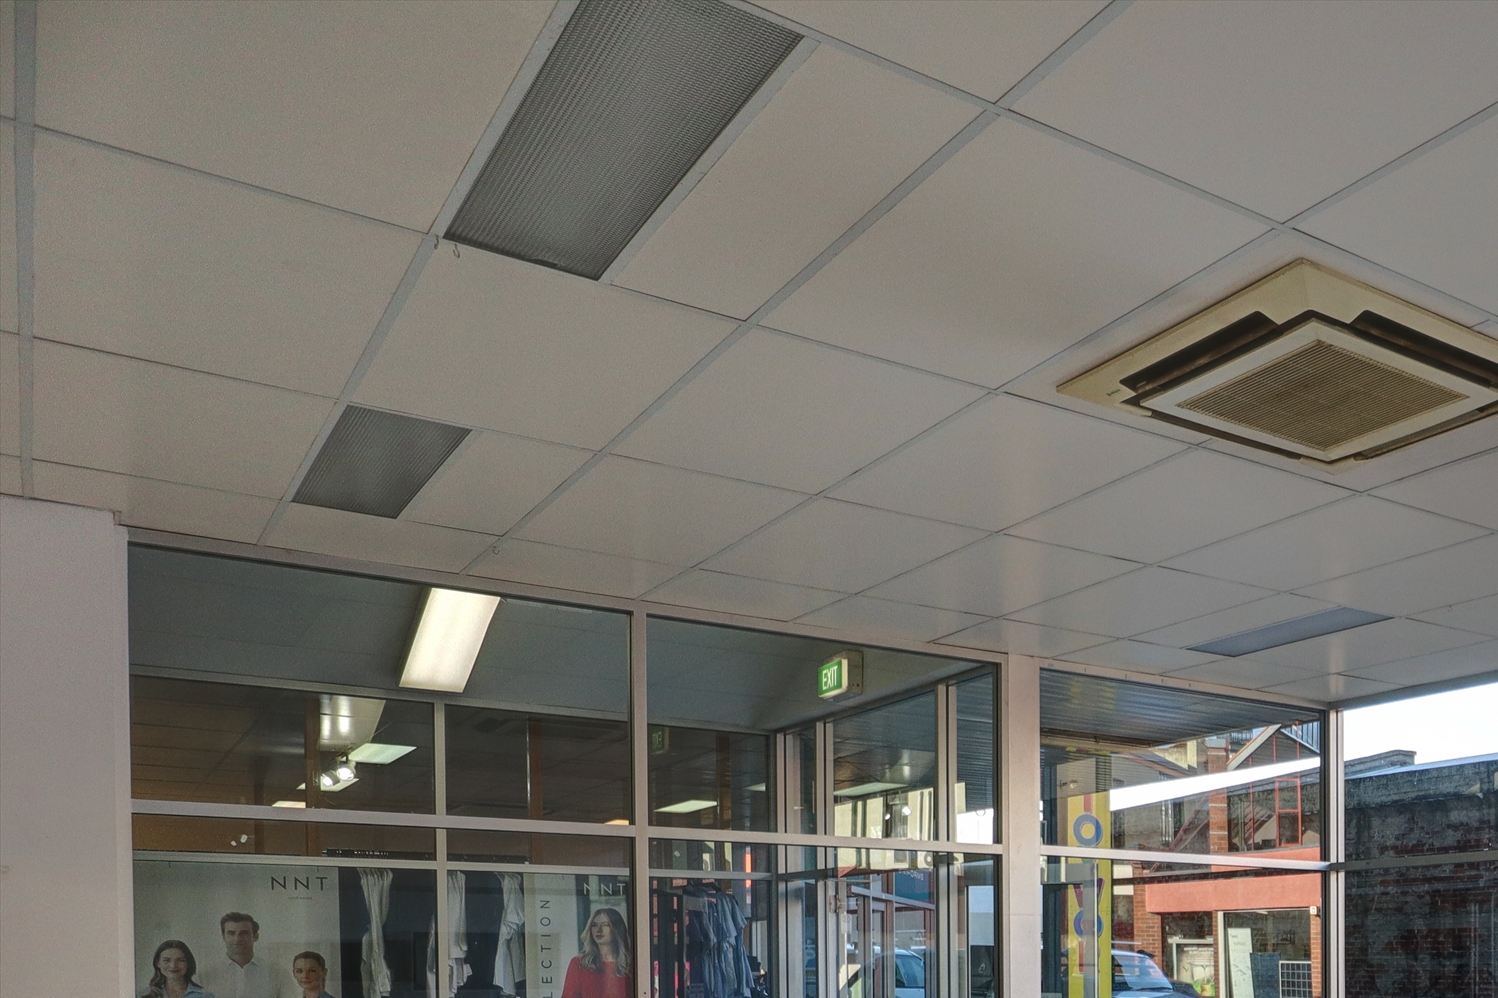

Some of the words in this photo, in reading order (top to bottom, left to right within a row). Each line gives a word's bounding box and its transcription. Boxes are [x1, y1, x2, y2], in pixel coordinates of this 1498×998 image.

[822, 665, 838, 690] EXIT
[271, 876, 328, 891] NNT
[584, 883, 626, 896] NNT
